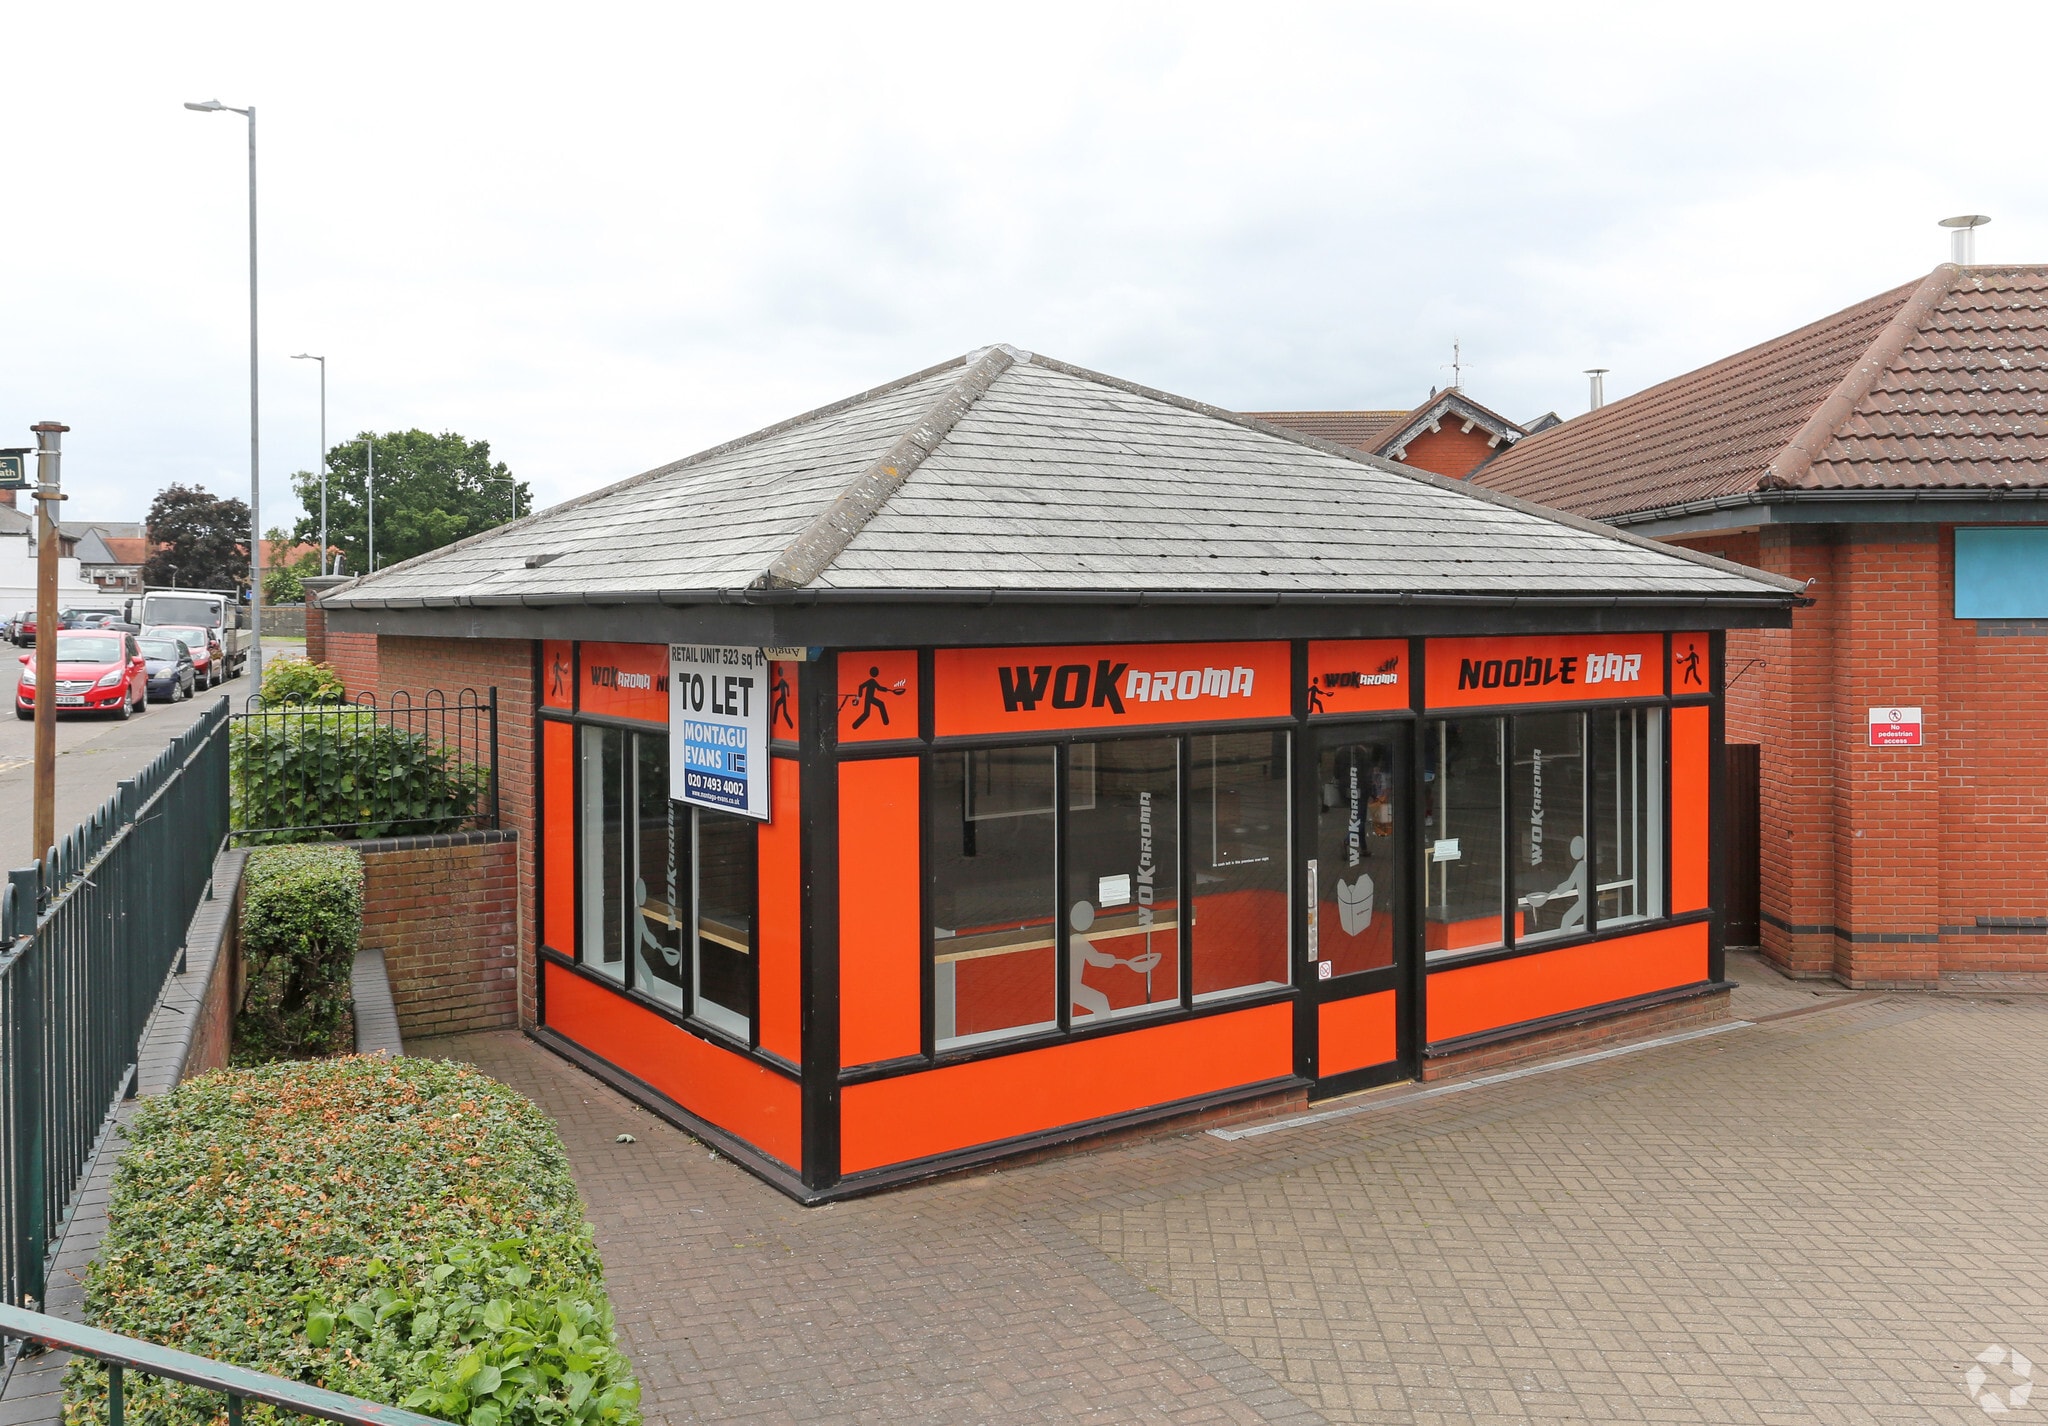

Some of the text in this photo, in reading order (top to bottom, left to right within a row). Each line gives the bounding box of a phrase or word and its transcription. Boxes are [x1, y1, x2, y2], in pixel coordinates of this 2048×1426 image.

[672, 647, 763, 670] RETAIL UNIT 523 sq ft
[1458, 653, 1642, 690] NOODLE BAR
[679, 673, 705, 712] TO
[712, 675, 753, 717] LET
[685, 722, 746, 748] MONTAGU
[685, 745, 722, 769] EVANS
[688, 773, 744, 796] 020 7493 4002
